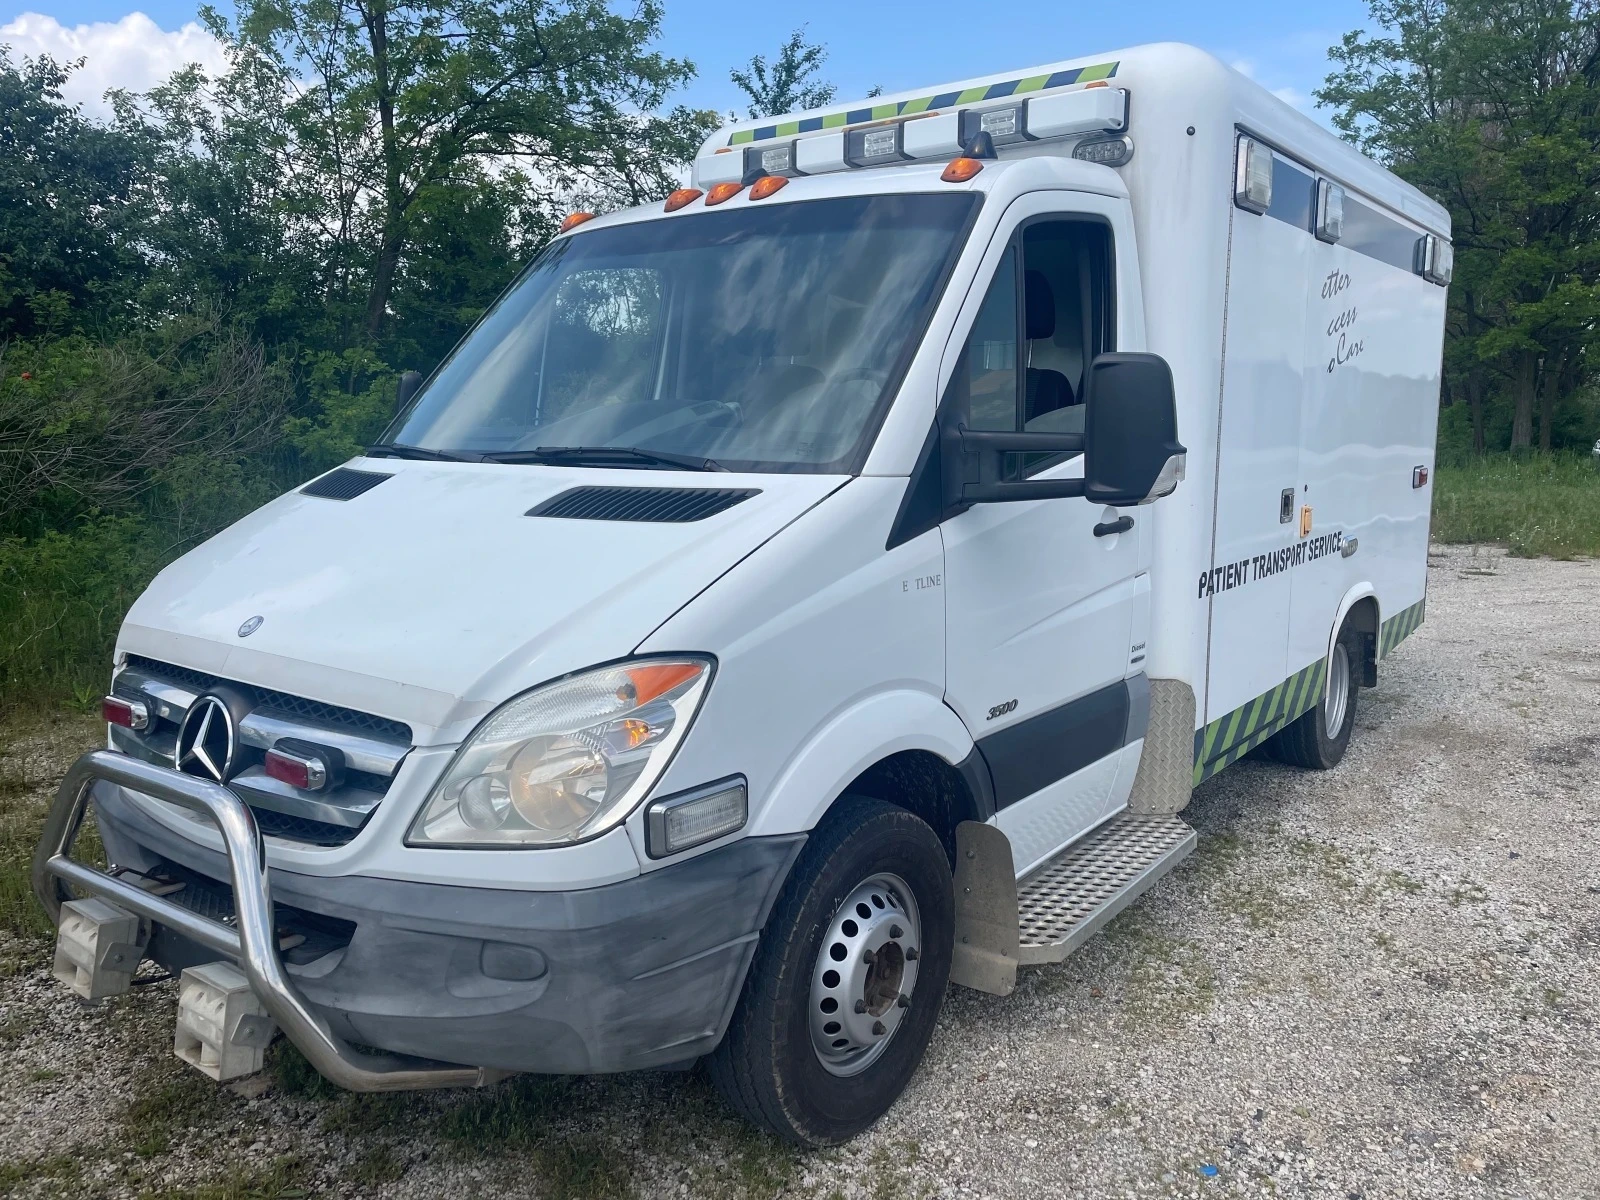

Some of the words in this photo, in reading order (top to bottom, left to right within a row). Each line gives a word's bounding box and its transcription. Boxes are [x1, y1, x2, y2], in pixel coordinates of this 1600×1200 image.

[1198, 559, 1250, 599] PATIENT
[1252, 541, 1307, 581] TRANSPORT
[1308, 530, 1342, 562] SERVICE
[986, 698, 1019, 720] 3500
